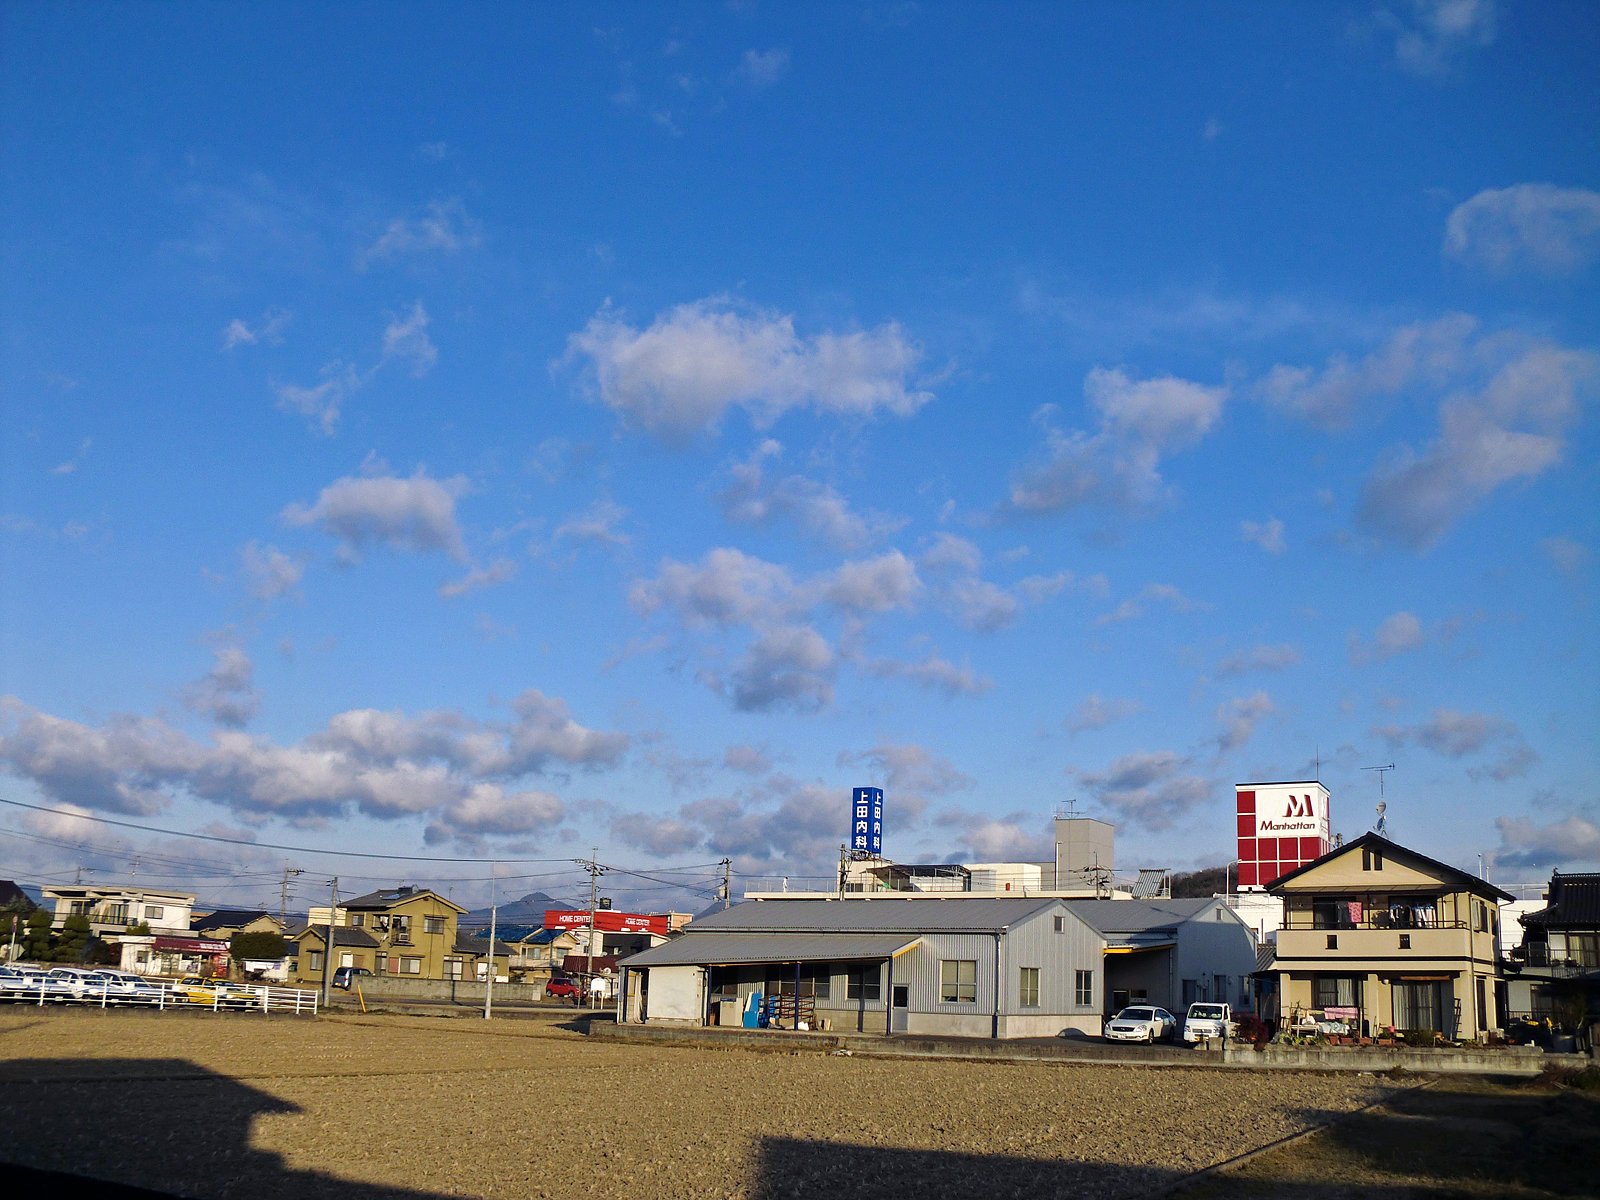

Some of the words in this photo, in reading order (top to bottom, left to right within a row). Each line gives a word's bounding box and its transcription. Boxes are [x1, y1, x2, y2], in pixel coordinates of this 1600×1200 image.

[856, 790, 868, 848] 上田内科
[873, 792, 881, 849] 上田内科
[1260, 820, 1315, 831] Manhattan
[636, 918, 650, 926] CENTER
